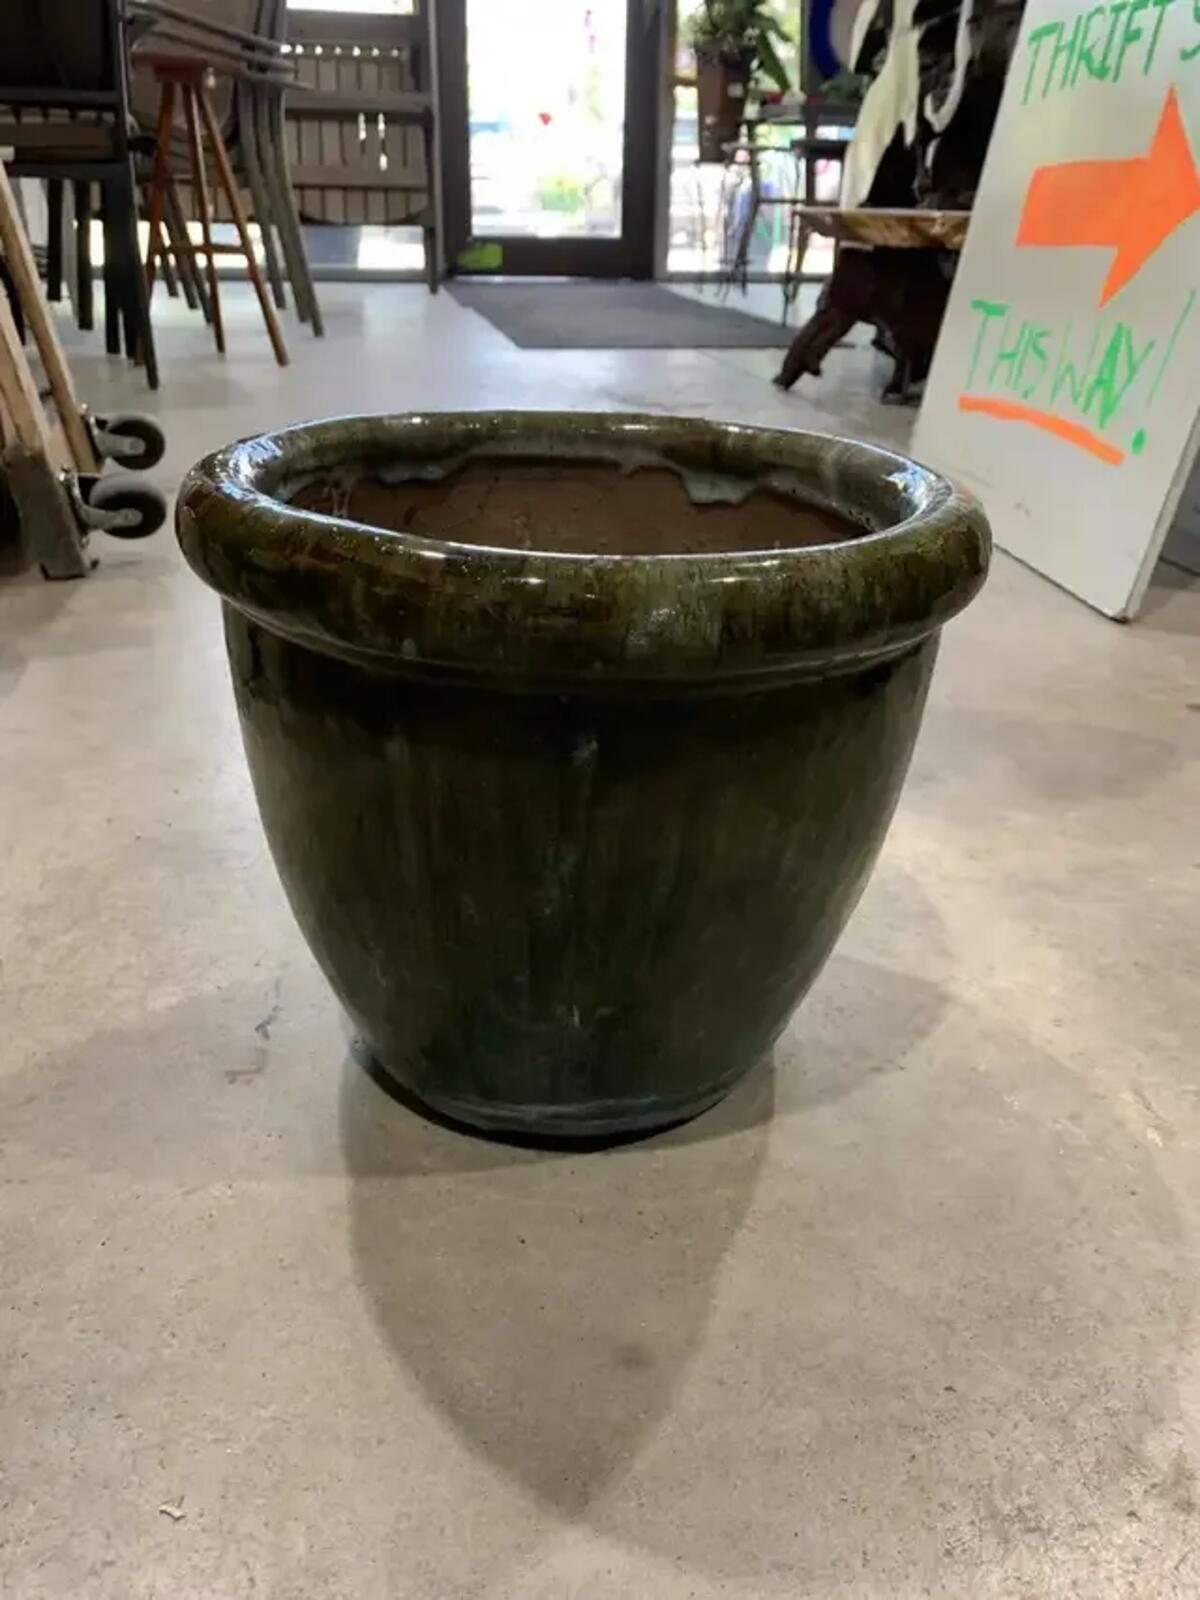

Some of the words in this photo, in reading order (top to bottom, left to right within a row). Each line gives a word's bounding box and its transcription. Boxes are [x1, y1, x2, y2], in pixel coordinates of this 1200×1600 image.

[1023, 0, 1174, 105] THRIFT
[966, 299, 1051, 399] THIS
[1049, 290, 1196, 455] WAY!
